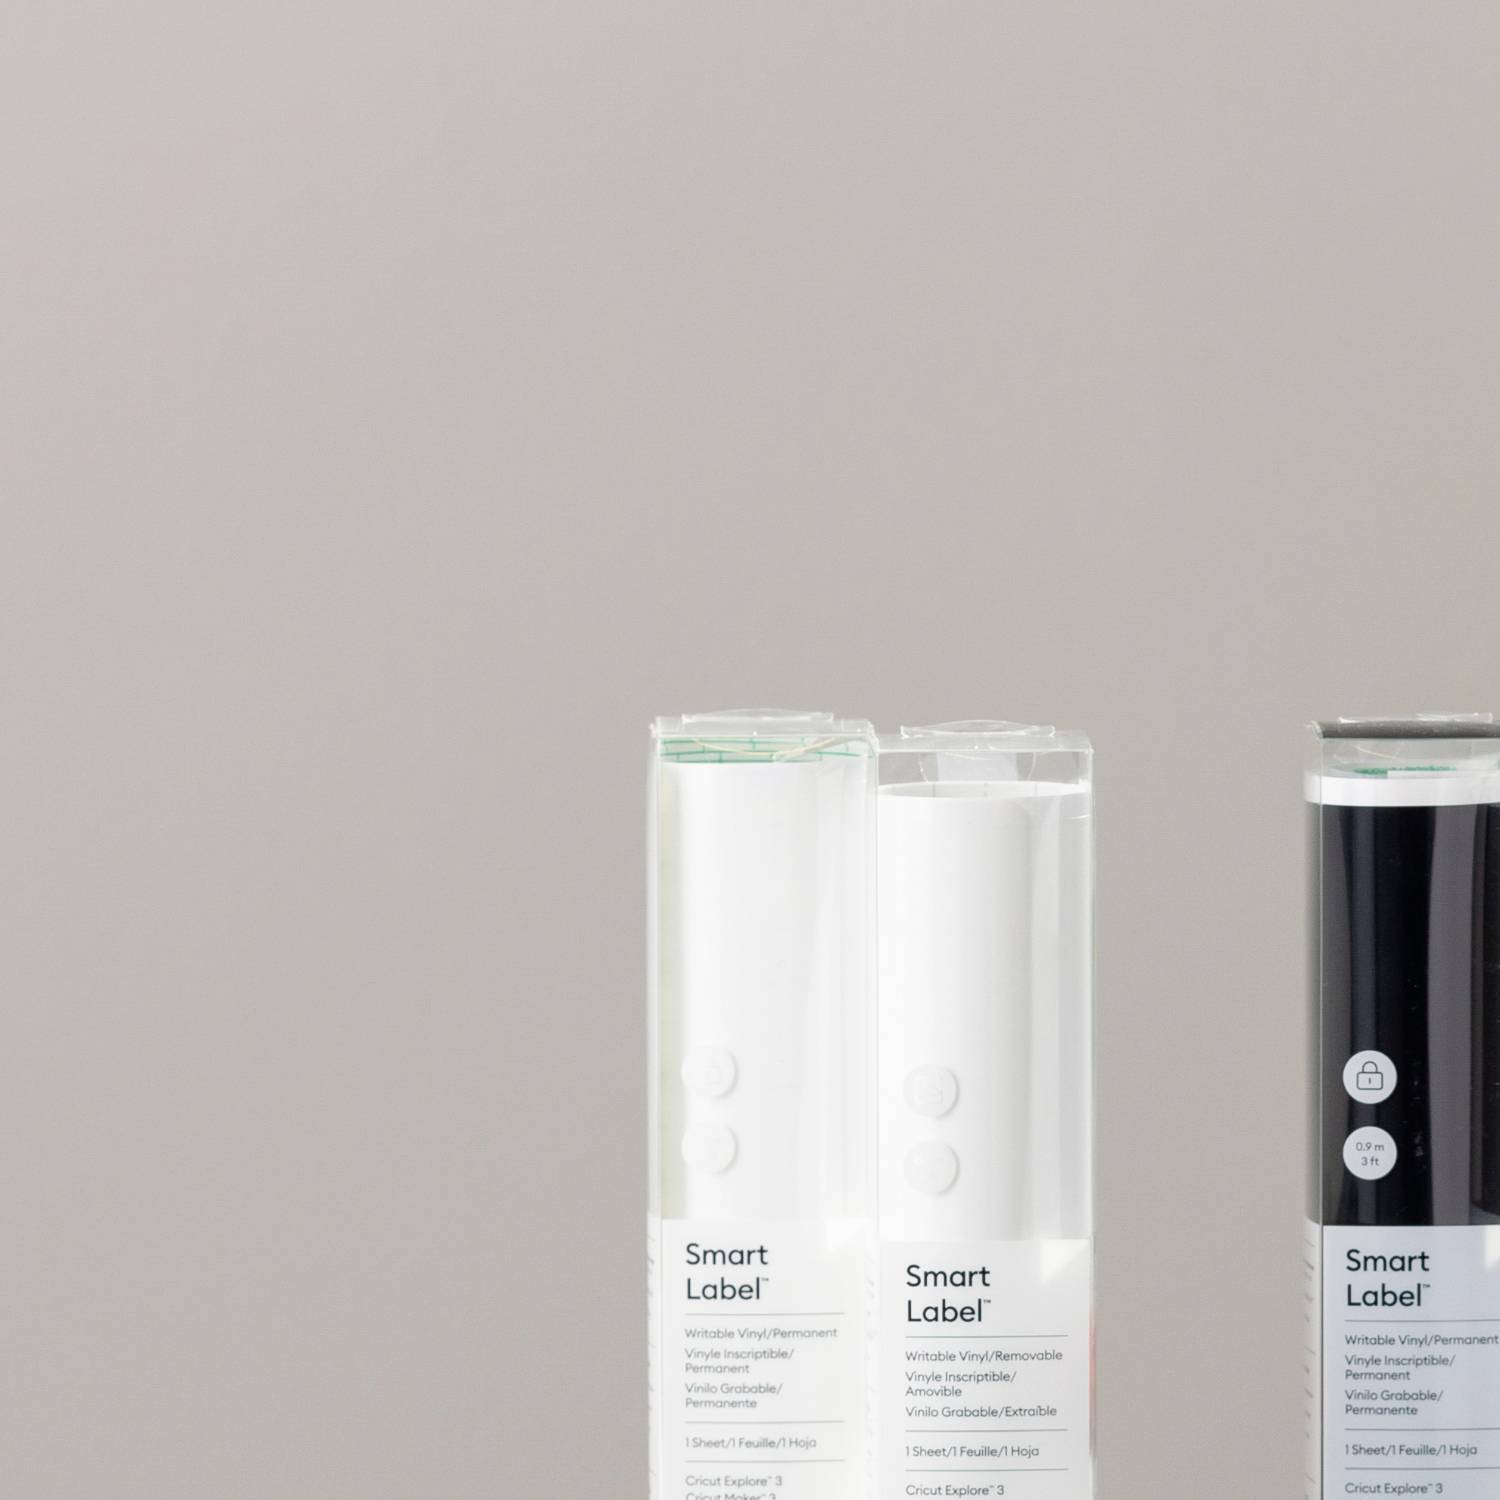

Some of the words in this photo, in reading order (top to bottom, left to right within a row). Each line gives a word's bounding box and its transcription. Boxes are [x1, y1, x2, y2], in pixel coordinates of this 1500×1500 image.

[1355, 1142, 1372, 1152] 0.9
[1361, 1156, 1368, 1166] 3
[1370, 1156, 1379, 1166] ft
[686, 1243, 768, 1266] Smart
[1346, 1248, 1430, 1272] Smart
[906, 1264, 990, 1287] Smart
[684, 1328, 735, 1339] Writable
[737, 1328, 838, 1341] Vinyl/Permanent
[1345, 1334, 1396, 1346] Writable
[1398, 1334, 1499, 1348] Vinyl/Permanent
[684, 1348, 721, 1362] Vinyle
[723, 1348, 795, 1361] Inscriptible/
[905, 1350, 956, 1362] Writable
[959, 1349, 1063, 1364] Vinyl/Removable
[1344, 1354, 1382, 1368] Vinyle
[1384, 1355, 1456, 1368] Inscriptible/
[685, 1362, 750, 1374] Permanent
[905, 1371, 942, 1384] Vinyle
[945, 1371, 1017, 1384] Inscriptible/
[1345, 1369, 1411, 1381] Permanent
[684, 1382, 718, 1394] Vinilo
[720, 1383, 783, 1395] Grabable/
[905, 1386, 962, 1397] Amovible
[1344, 1389, 1378, 1401] Vinilo
[1380, 1389, 1444, 1402] Grabable/
[905, 1406, 939, 1418] Vinilo
[1345, 1404, 1418, 1416] Permanente
[789, 1437, 817, 1450] Hoja
[1011, 1445, 1039, 1459] Hoja
[1449, 1444, 1478, 1457] Hoja
